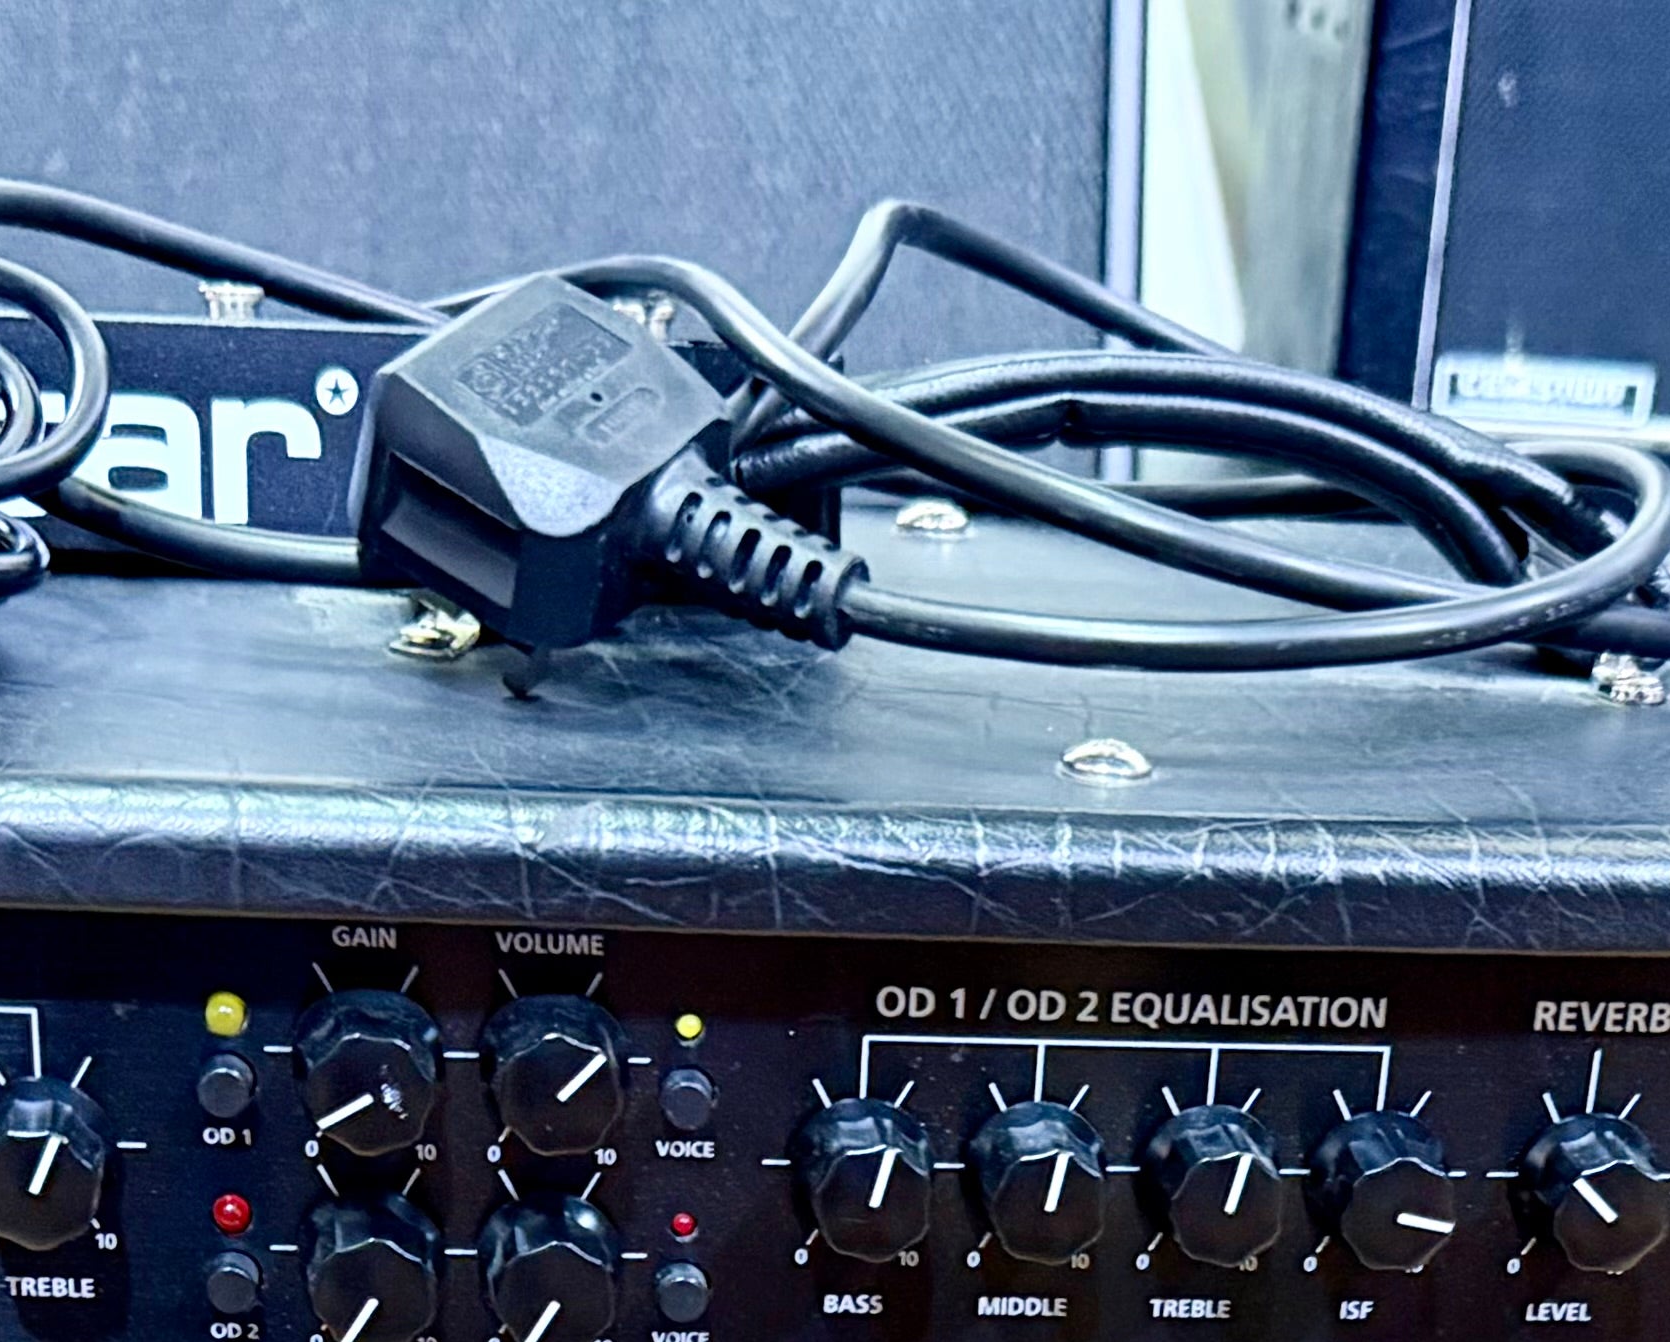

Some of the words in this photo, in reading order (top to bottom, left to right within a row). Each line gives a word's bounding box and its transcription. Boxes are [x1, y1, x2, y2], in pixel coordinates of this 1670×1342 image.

[331, 925, 397, 949] GAIN
[495, 931, 604, 956] VOLUME
[876, 985, 936, 1018] OD
[950, 987, 966, 1019] 1
[1007, 989, 1067, 1021] OD
[1076, 990, 1099, 1022] 2
[1110, 991, 1388, 1029] EQUALISATION
[202, 1127, 236, 1145] OD
[242, 1128, 252, 1146] 1
[304, 1139, 319, 1158] 0
[415, 1143, 437, 1161] 10
[486, 1144, 502, 1163] 0
[594, 1148, 617, 1166] 10
[655, 1140, 715, 1159] VOICE
[94, 1232, 118, 1250] 10
[794, 1248, 809, 1265] 0
[897, 1250, 920, 1267] 10
[966, 1250, 981, 1268] 0
[1070, 1252, 1090, 1270] 10
[1135, 1253, 1150, 1271] 0
[1303, 1256, 1318, 1273] 0
[1506, 1257, 1521, 1274] 0
[4, 1276, 96, 1299] TREBLE
[823, 1294, 883, 1315] BASS
[977, 1296, 1067, 1317] MIDDLE
[1149, 1298, 1231, 1319] TREBLE
[1339, 1300, 1374, 1320] ISF
[1525, 1302, 1592, 1322] LEVEL
[210, 1322, 242, 1340] OD
[247, 1323, 260, 1340] 2
